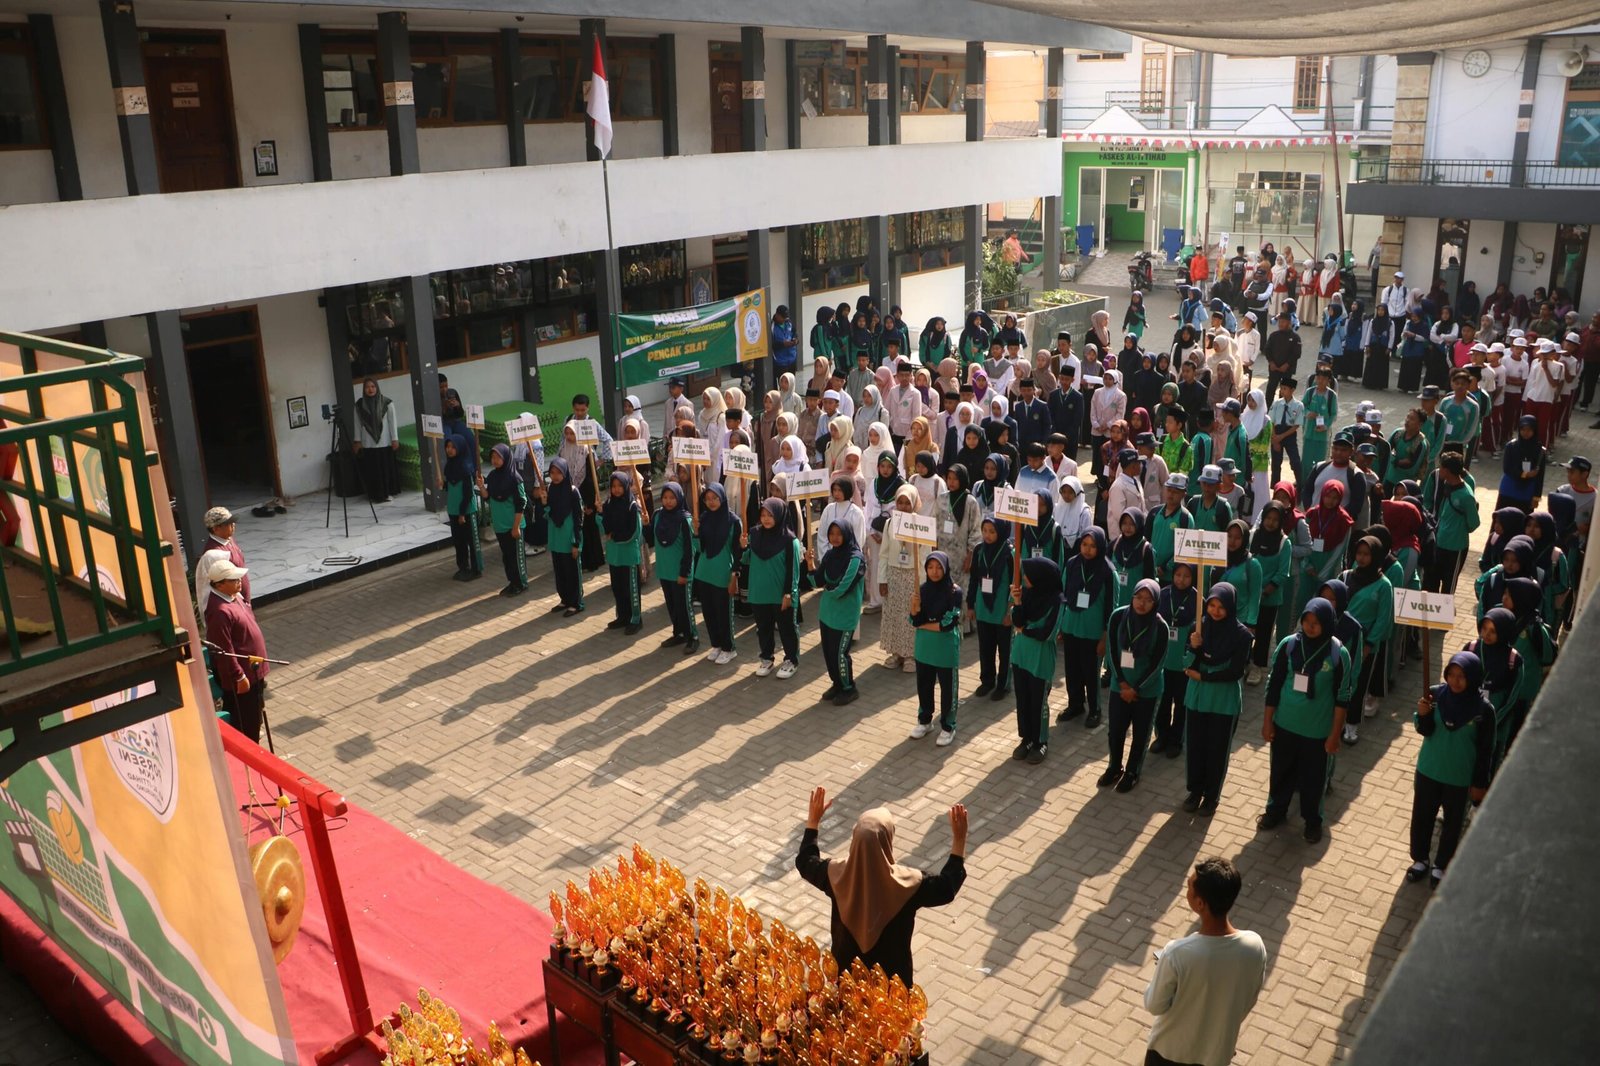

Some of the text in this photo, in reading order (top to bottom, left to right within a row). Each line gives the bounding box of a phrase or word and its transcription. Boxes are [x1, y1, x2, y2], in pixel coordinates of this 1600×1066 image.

[648, 341, 708, 361] PENCAK SILAT
[730, 455, 754, 464] PENCAK
[734, 463, 751, 471] SILAT
[796, 478, 823, 488] SINGER
[1007, 496, 1030, 506] TENIS
[1008, 504, 1029, 515] MEJA
[904, 522, 930, 533] CATUR
[1185, 540, 1221, 550] ATLETIK
[1410, 602, 1442, 613] VOLLY
